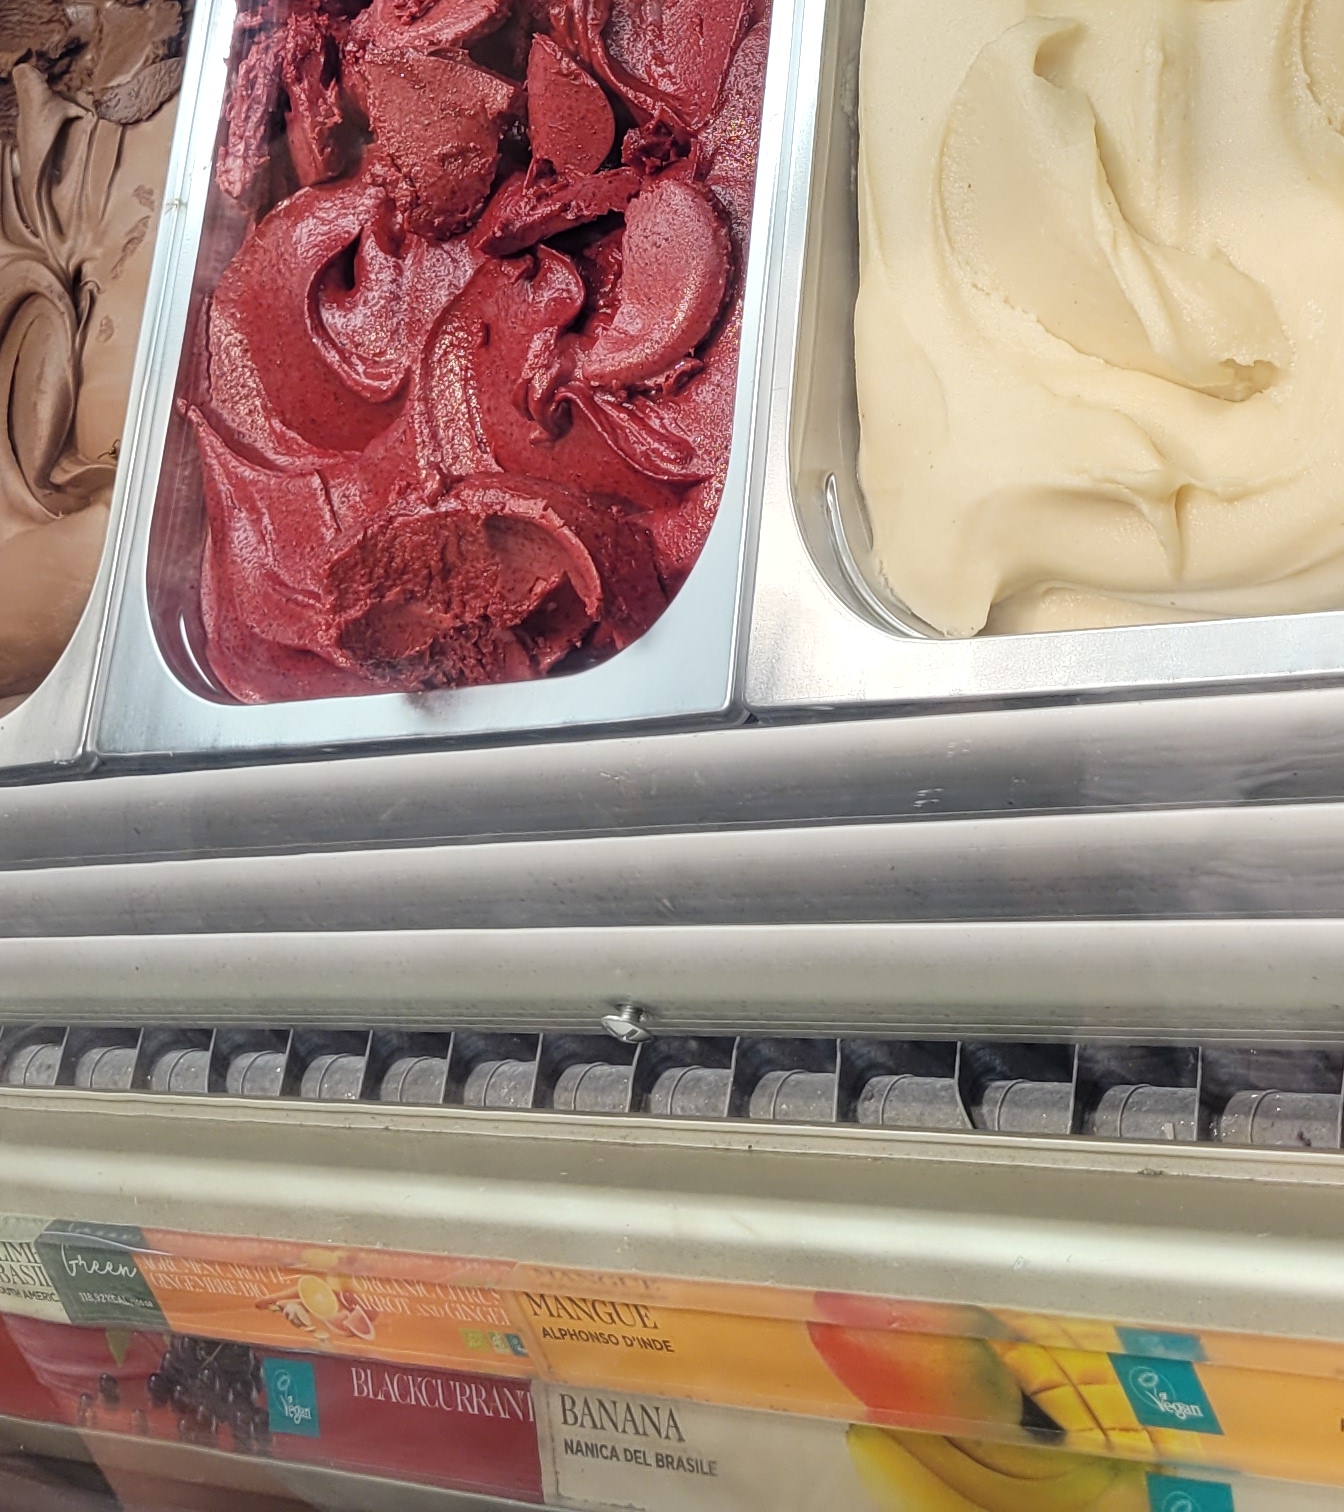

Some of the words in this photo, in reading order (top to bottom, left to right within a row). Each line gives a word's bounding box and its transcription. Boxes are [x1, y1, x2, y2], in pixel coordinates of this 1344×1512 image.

[60, 1243, 138, 1279] Green
[22, 1289, 62, 1303] AMERIC
[339, 1291, 412, 1316] CARROT
[523, 1290, 660, 1330] MANGUE
[541, 1325, 620, 1347] ALPHONSO
[621, 1334, 676, 1354] D'INDE
[279, 1392, 313, 1423] Vegan
[350, 1366, 536, 1423] BLACKCURRANT
[1148, 1389, 1205, 1421] Vegan
[558, 1392, 687, 1444] BANANA
[563, 1437, 621, 1463] NANICA
[623, 1448, 653, 1468] DEL
[655, 1452, 719, 1477] BRASILE
